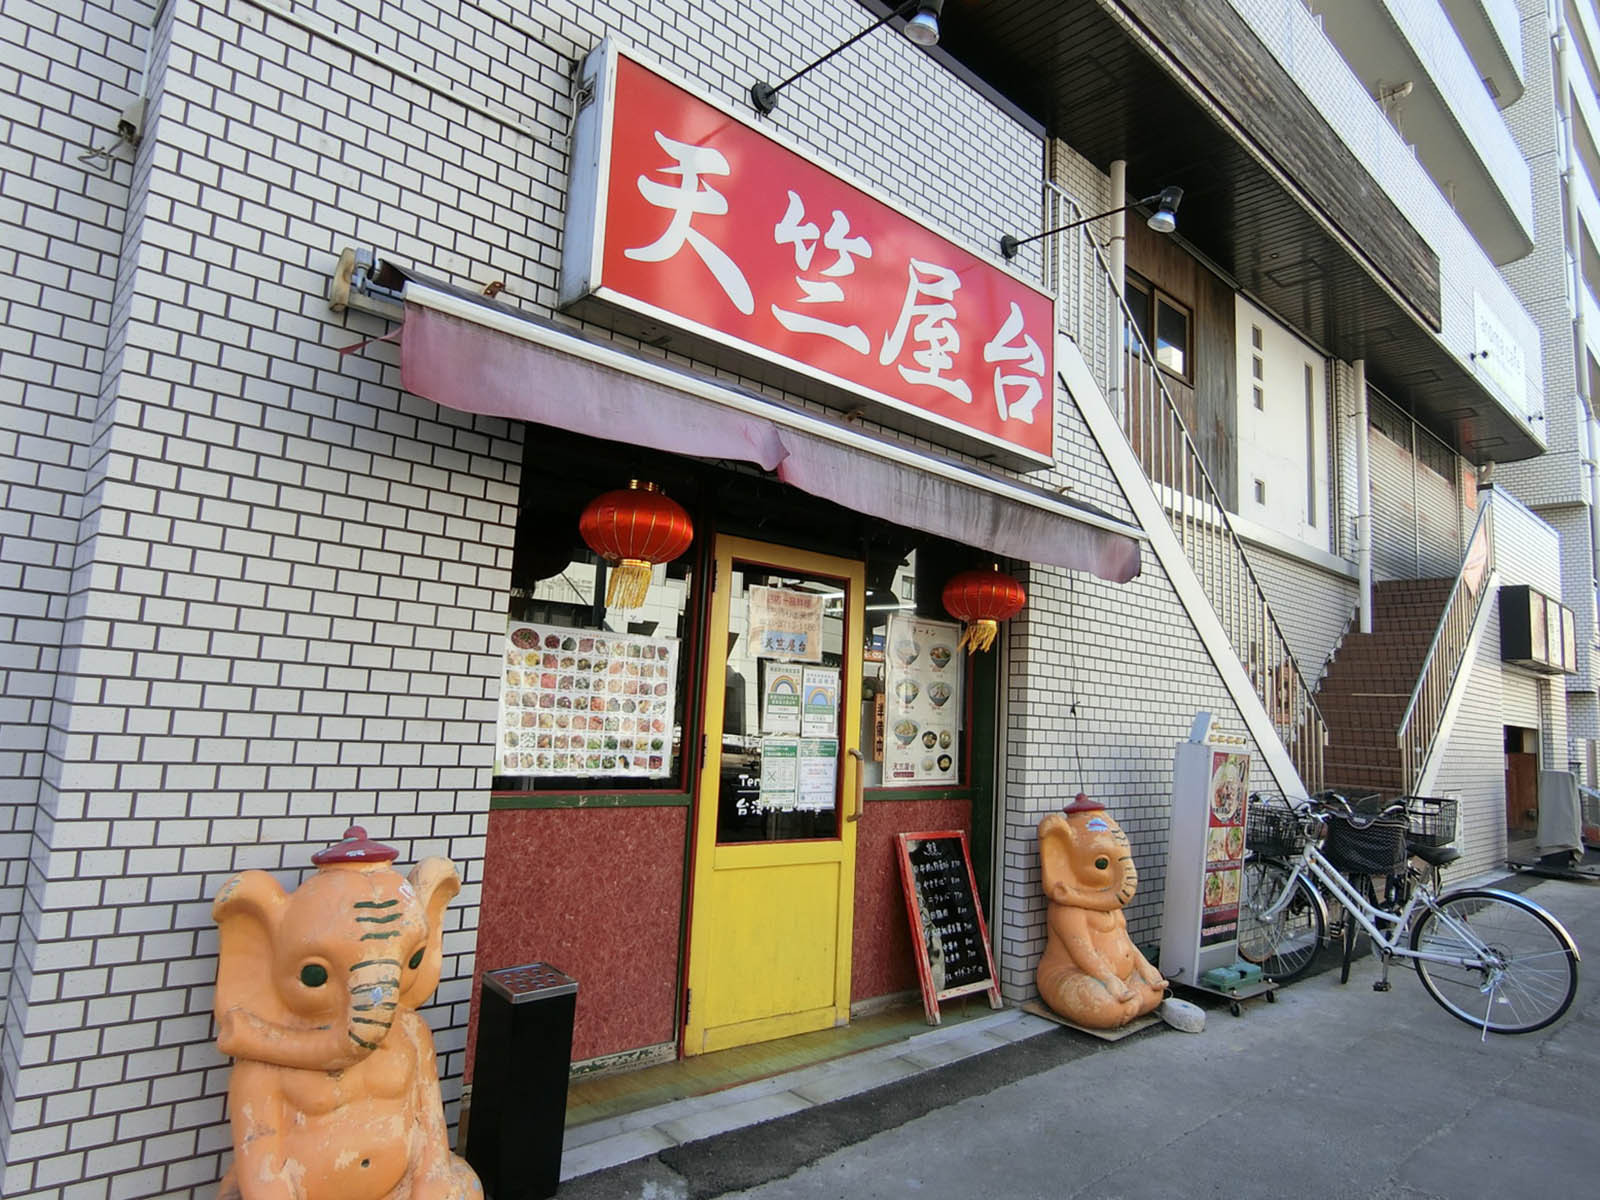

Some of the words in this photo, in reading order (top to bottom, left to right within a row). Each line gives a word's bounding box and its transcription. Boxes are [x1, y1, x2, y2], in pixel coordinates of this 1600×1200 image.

[624, 130, 1047, 424] 天竺屋台
[764, 637, 806, 652] 天竺屋台
